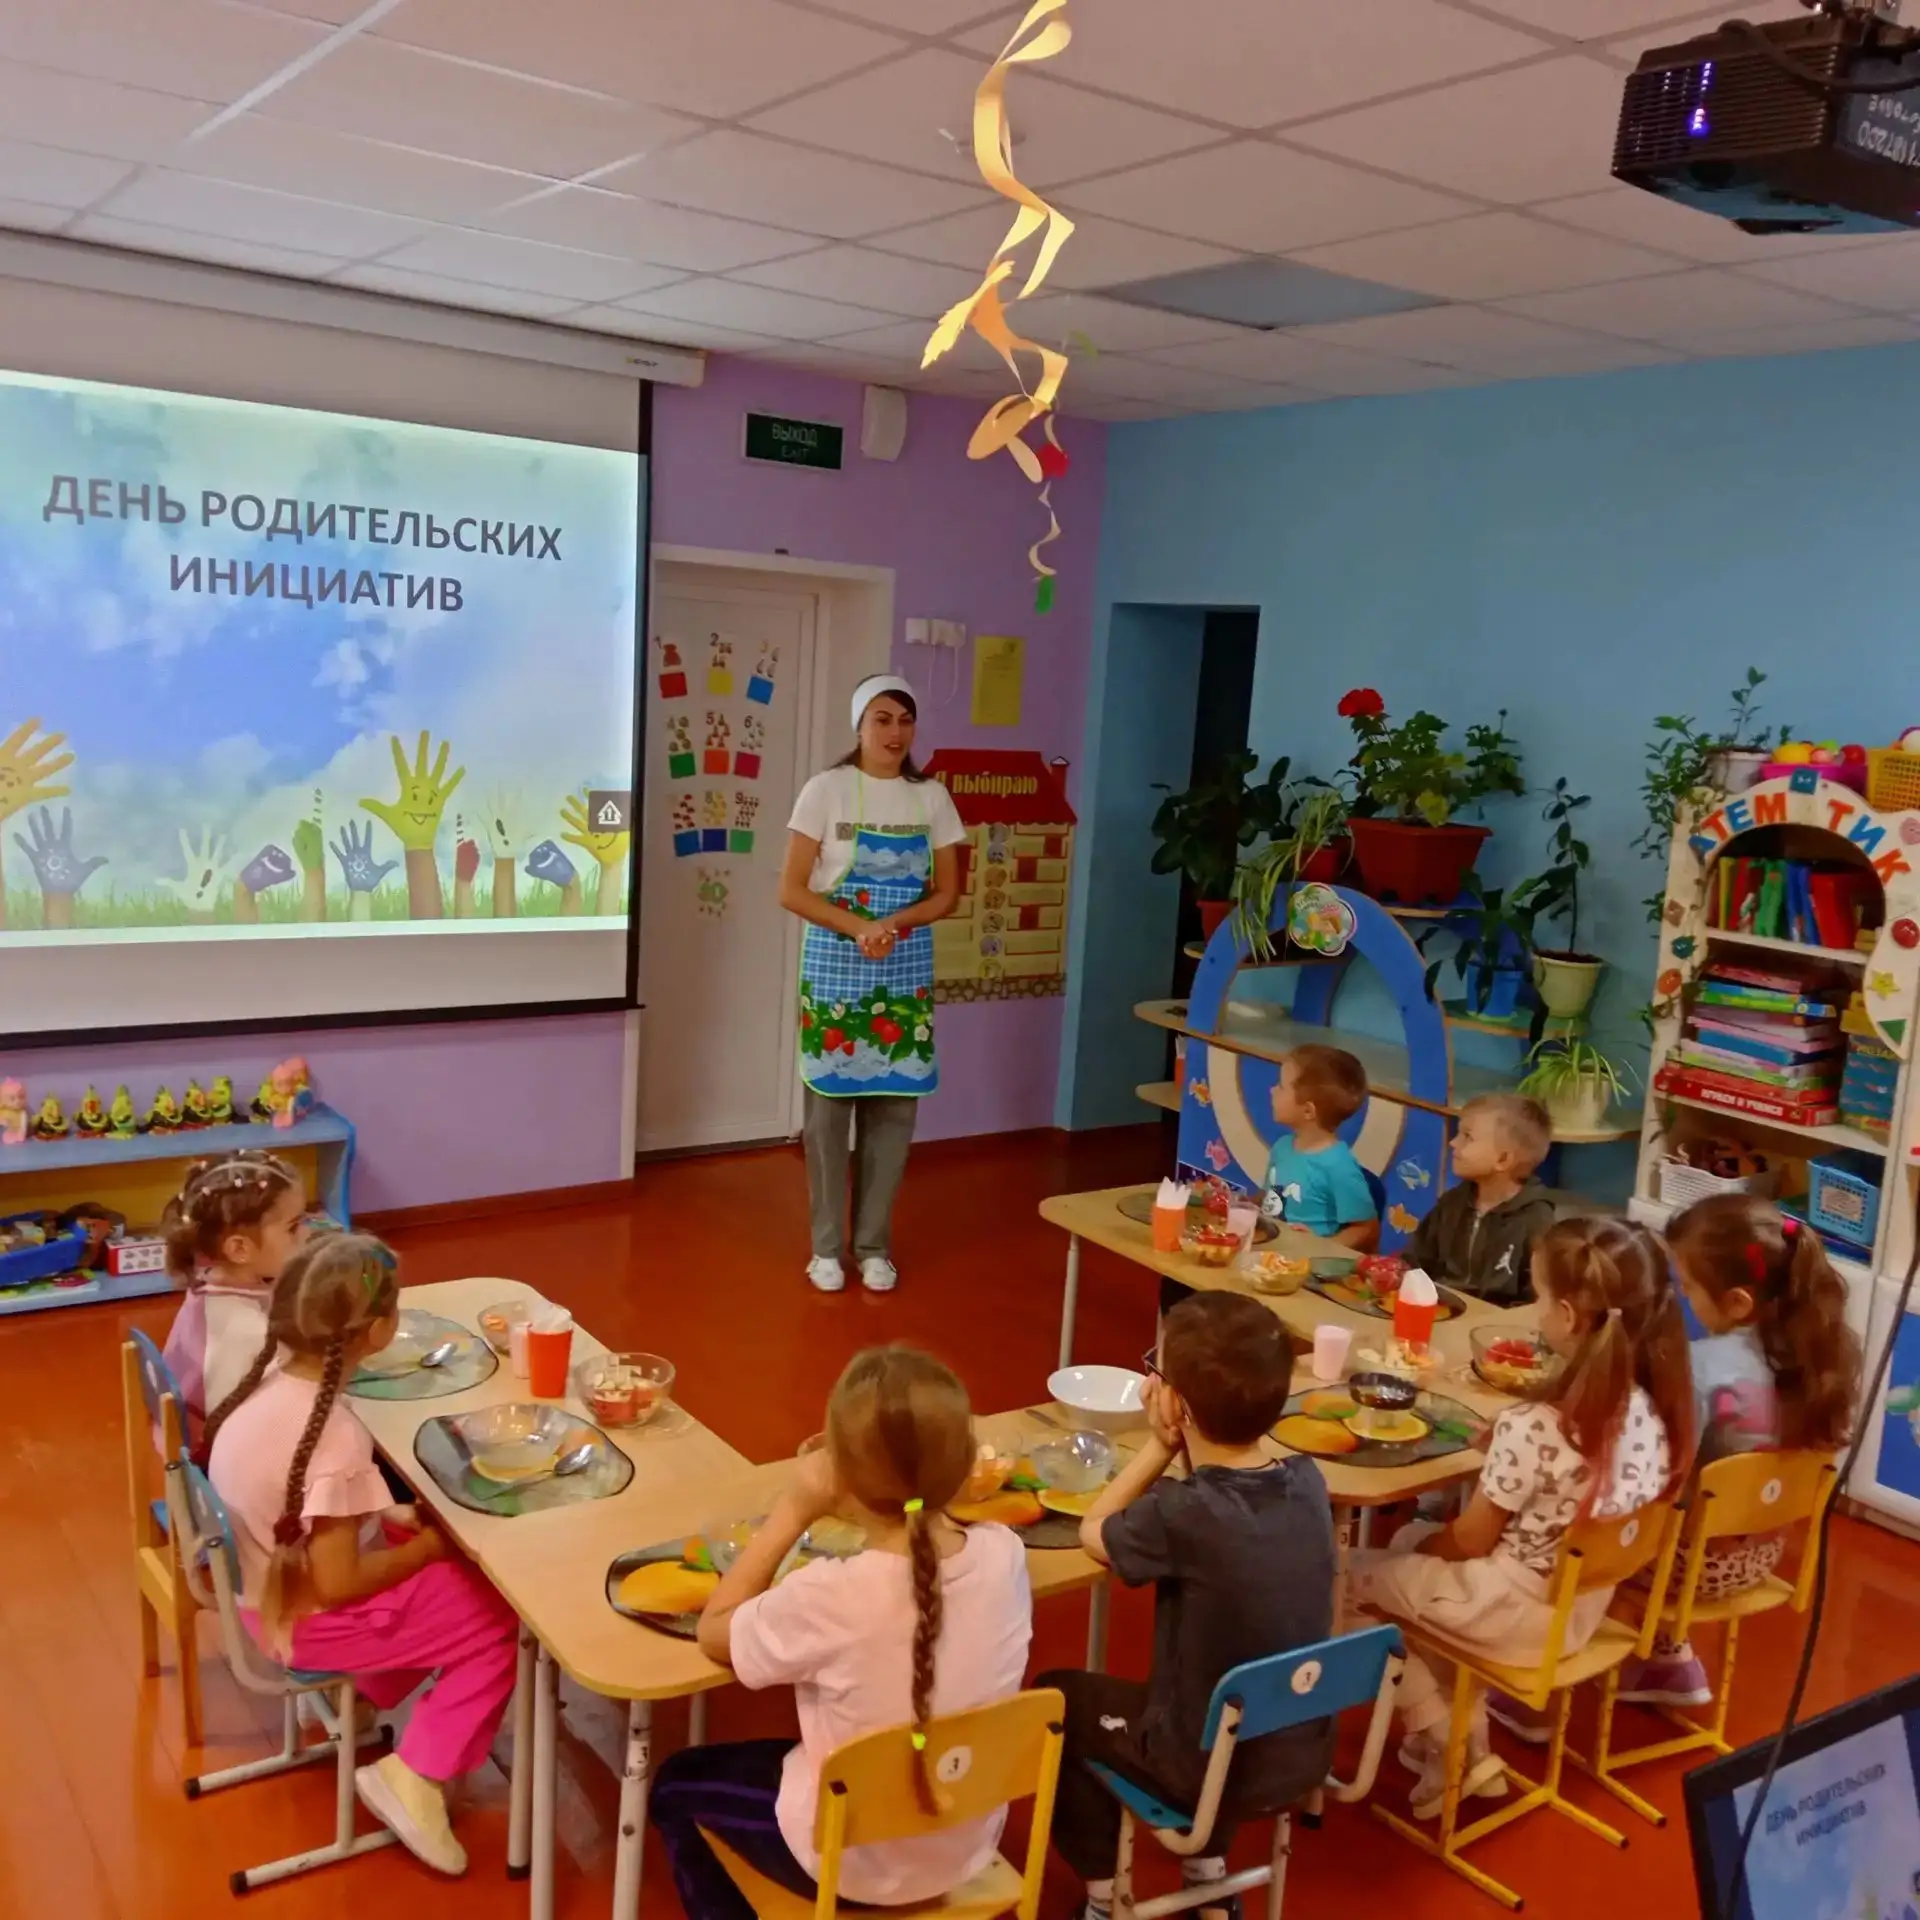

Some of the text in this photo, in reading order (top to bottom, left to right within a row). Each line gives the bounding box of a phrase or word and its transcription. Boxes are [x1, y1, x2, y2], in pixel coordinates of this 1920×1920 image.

[42, 475, 563, 561] ДЕНЬ РОДИТЕЛЬСКИХ
[169, 554, 465, 613] ИНИЦИАТИВ
[709, 632, 719, 647] 2
[705, 712, 715, 726] 5
[743, 715, 754, 729] 6
[951, 770, 1038, 799] выбираю
